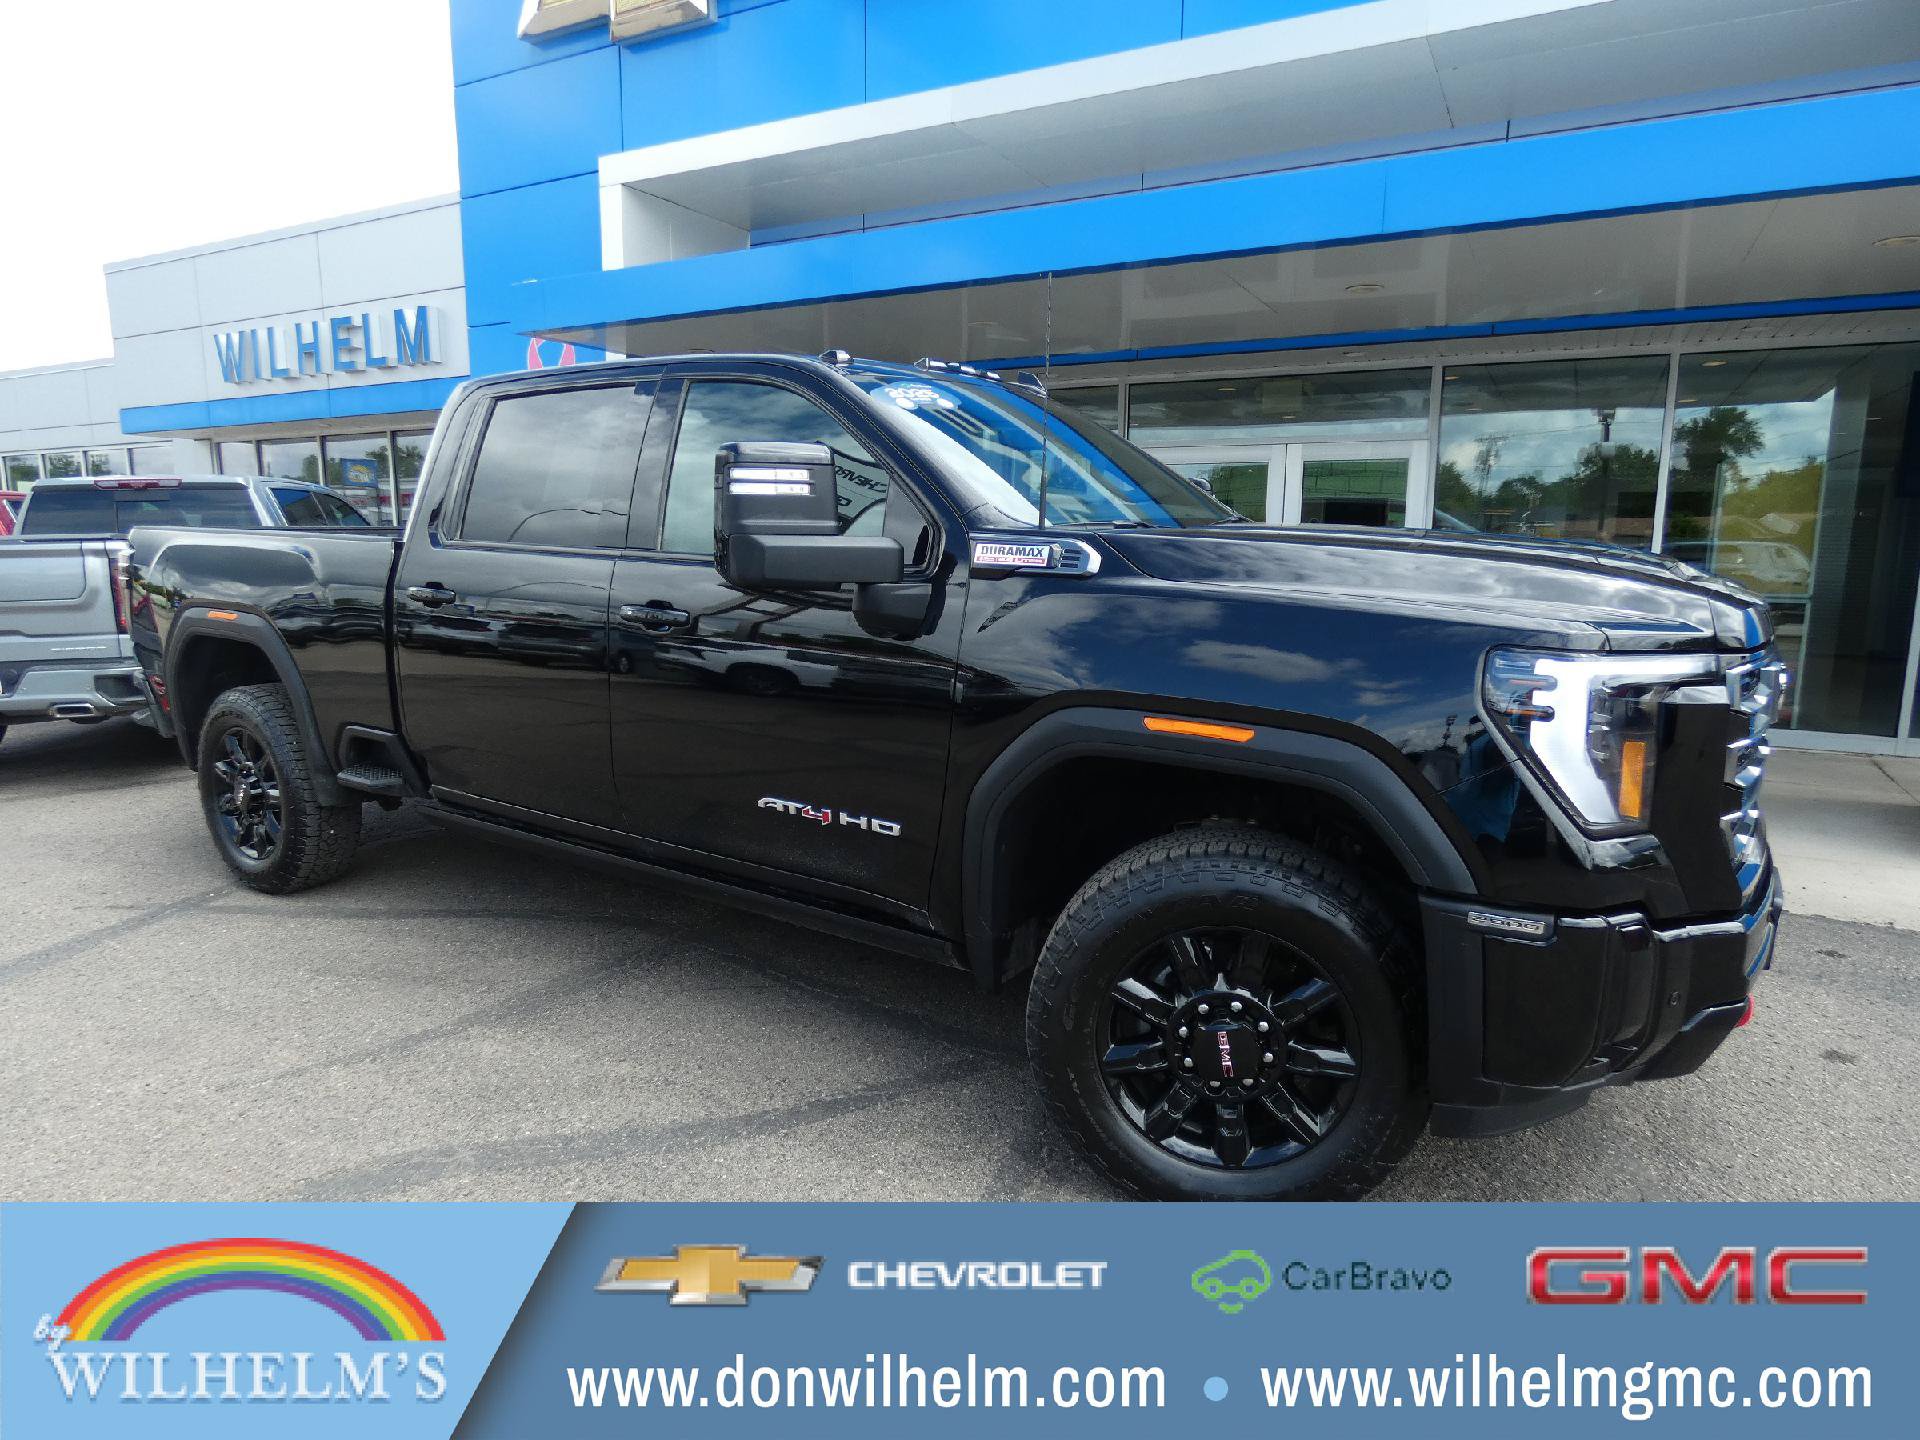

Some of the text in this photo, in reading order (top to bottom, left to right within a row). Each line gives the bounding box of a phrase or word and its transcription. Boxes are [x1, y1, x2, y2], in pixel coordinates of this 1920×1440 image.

[213, 306, 433, 384] WILHELM
[981, 545, 1045, 557] DURAMAX
[757, 797, 901, 837] AT4 HD
[1217, 1031, 1233, 1078] GMC
